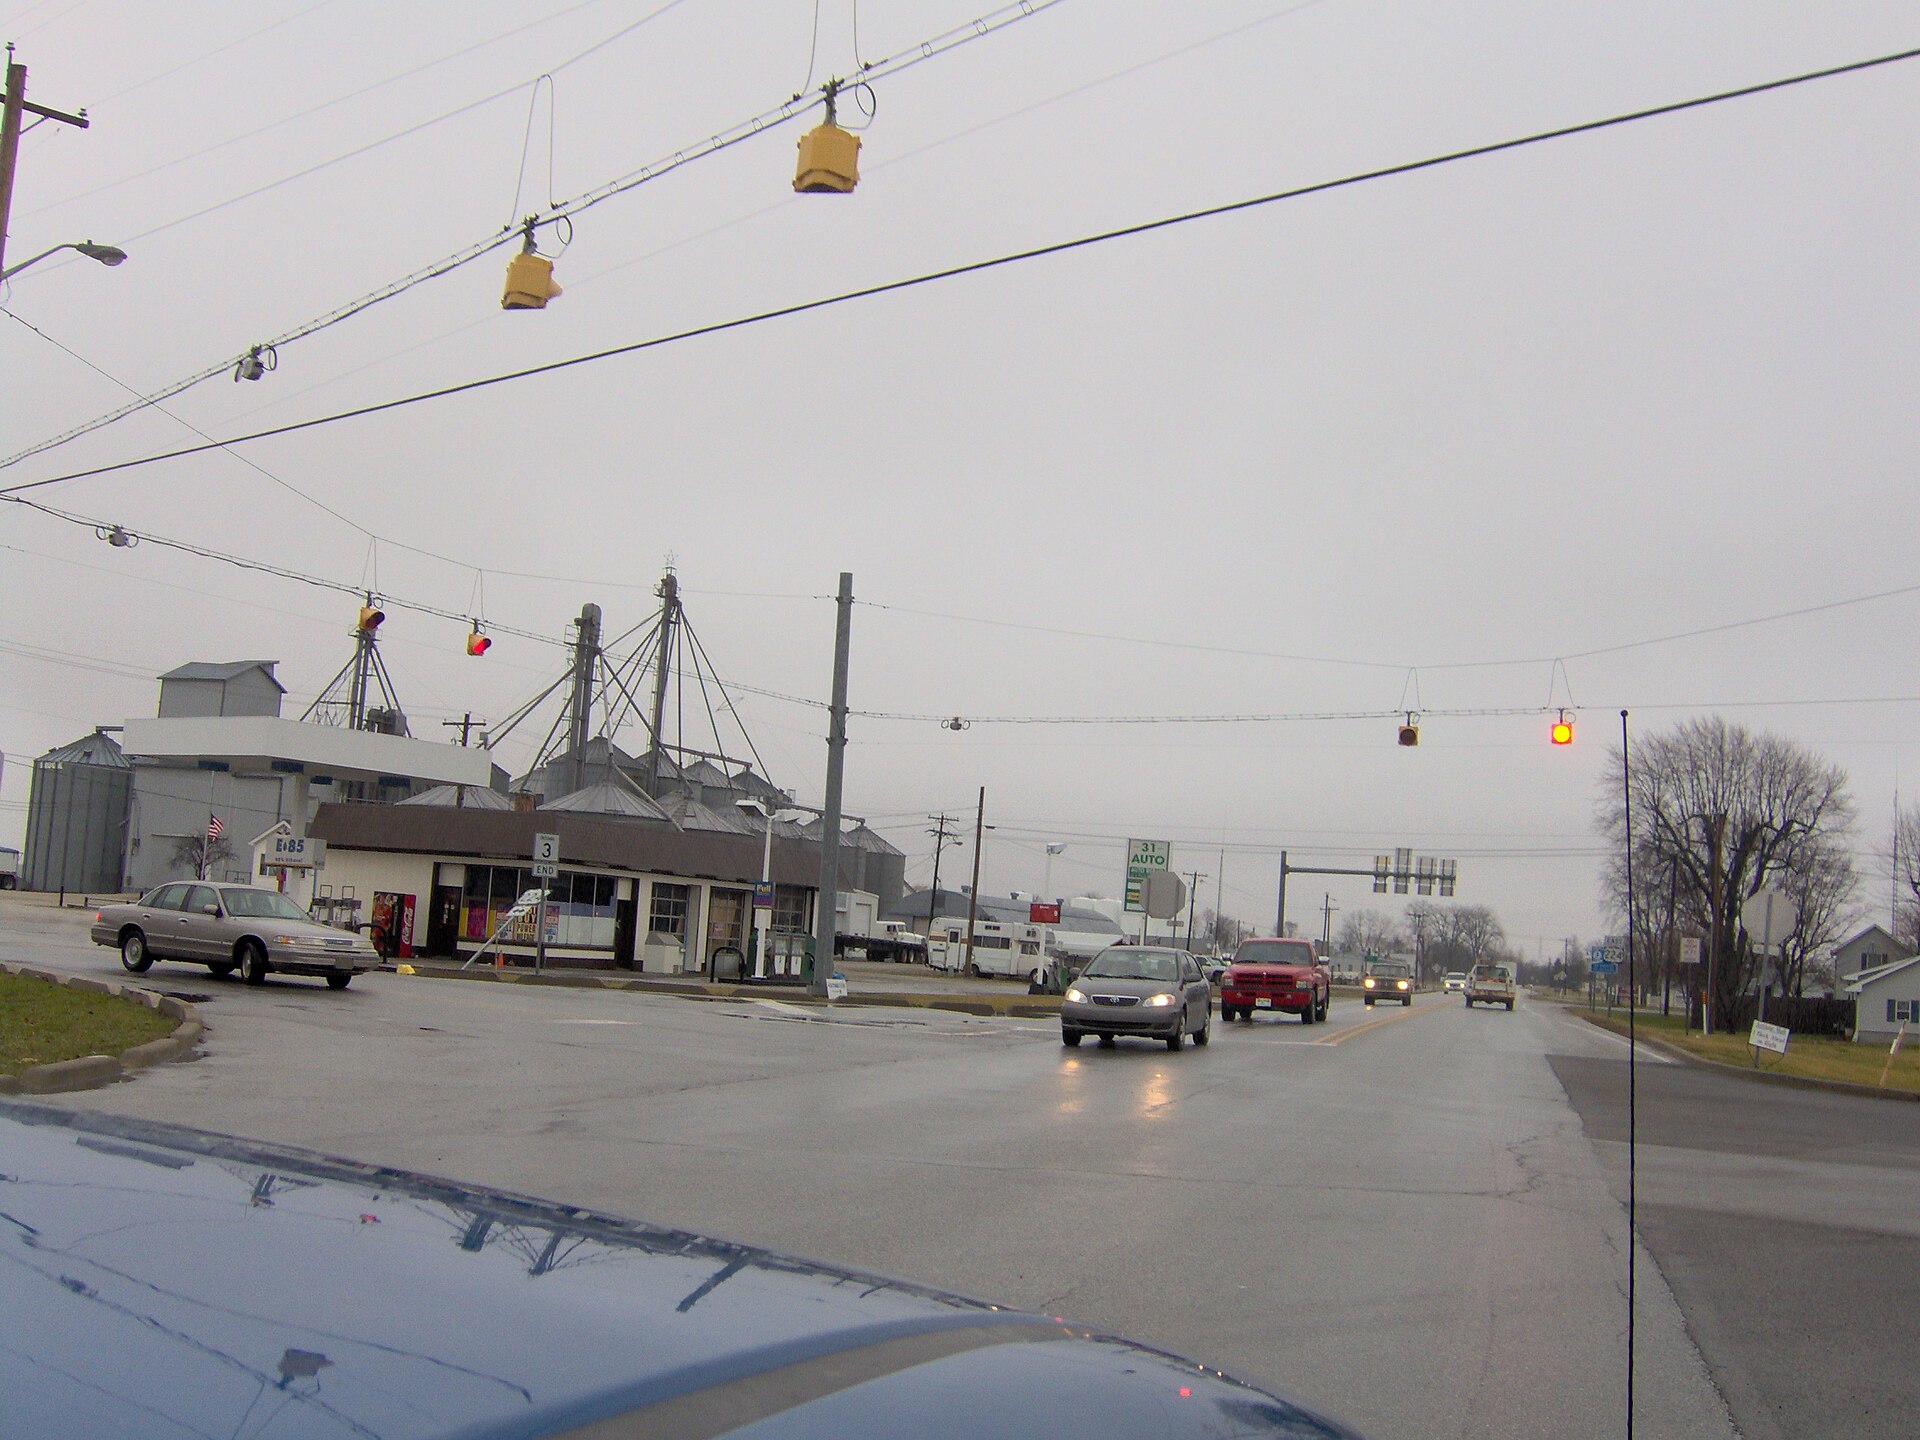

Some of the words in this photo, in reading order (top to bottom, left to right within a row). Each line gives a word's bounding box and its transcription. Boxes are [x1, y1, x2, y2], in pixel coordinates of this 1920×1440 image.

[542, 843, 551, 858] 3
[1142, 843, 1155, 853] 31
[1131, 854, 1165, 865] AUTO
[537, 865, 554, 875] END
[517, 914, 537, 924] BUY
[1605, 949, 1623, 960] 224
